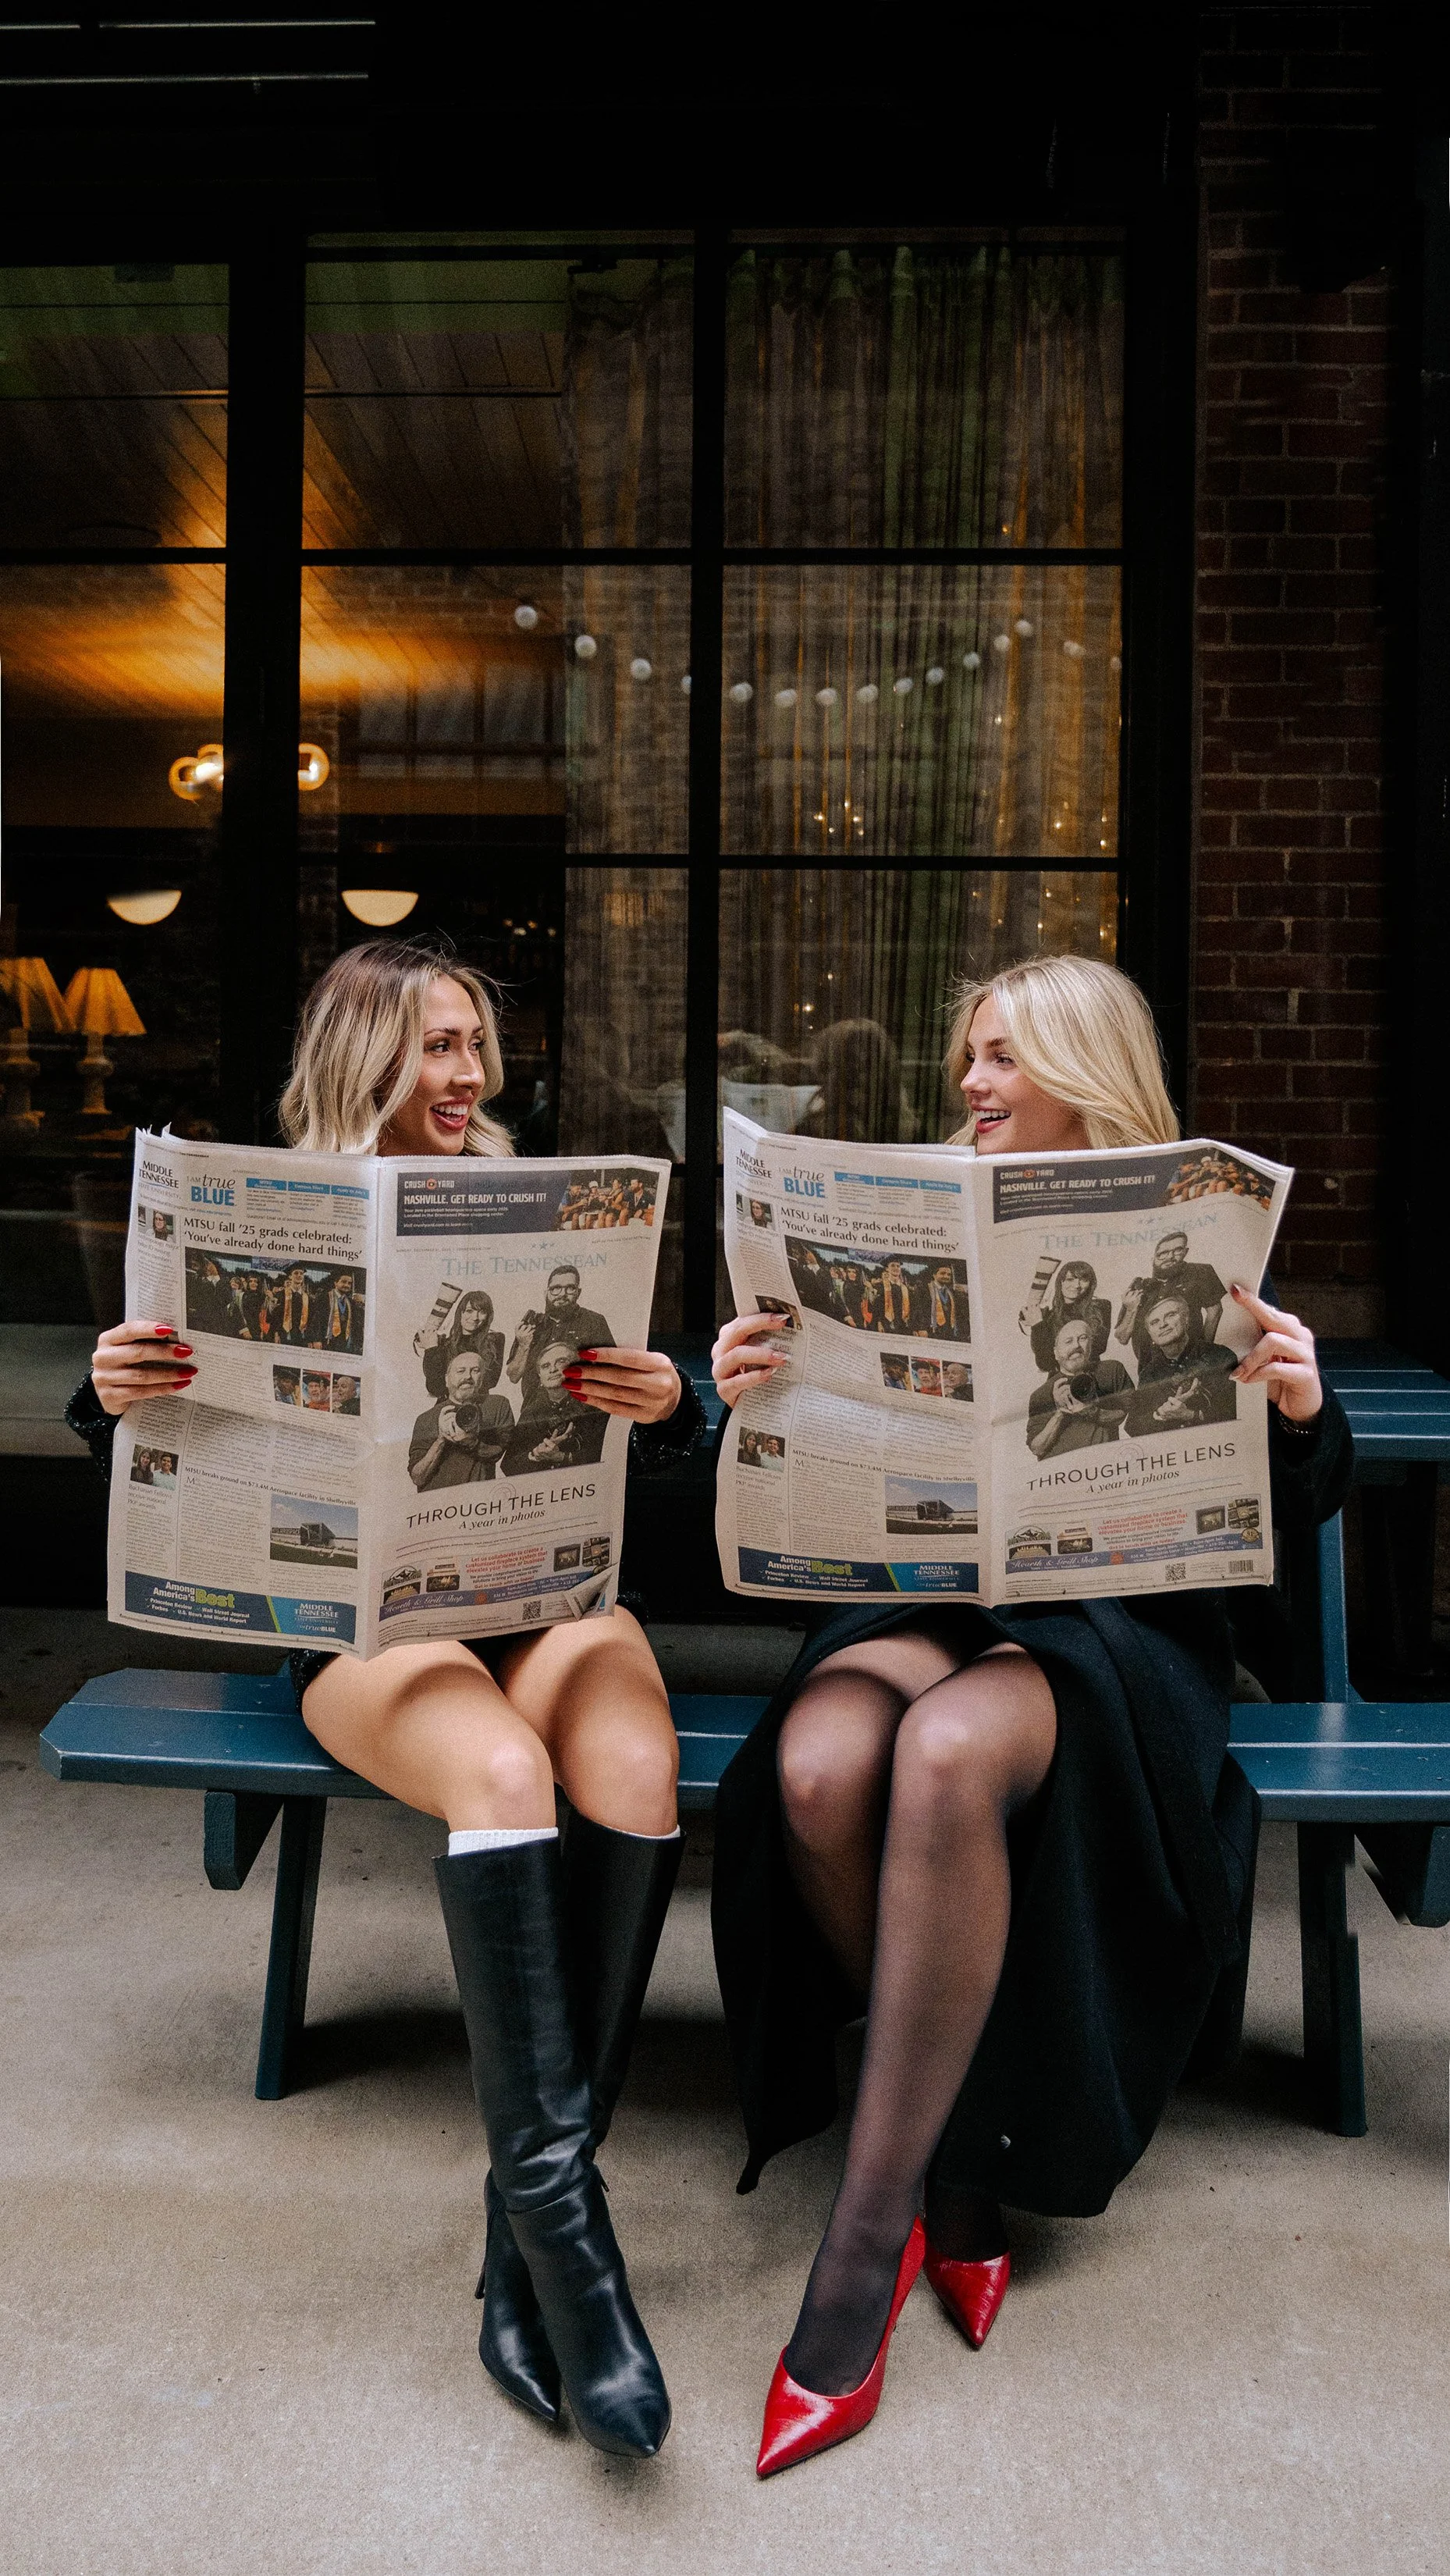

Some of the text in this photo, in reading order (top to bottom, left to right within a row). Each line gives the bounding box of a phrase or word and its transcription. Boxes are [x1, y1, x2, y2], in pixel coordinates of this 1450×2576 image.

[736, 1156, 773, 1179] TENNESSEE
[740, 1148, 766, 1169] MIDDLE
[143, 1160, 173, 1177] MIDDLE
[794, 1166, 825, 1183] true
[1000, 1171, 1023, 1180] CRUSH
[139, 1169, 179, 1188] TENNESSEE
[202, 1173, 236, 1189] true
[404, 1179, 455, 1189] CRUSH YARD
[784, 1176, 826, 1198] BLUE
[1050, 1180, 1065, 1190] GET
[1068, 1179, 1096, 1188] READY
[1100, 1178, 1111, 1187] TO
[1113, 1176, 1142, 1186] CRUSH
[1144, 1175, 1155, 1184] IT!
[191, 1186, 235, 1206] BLUE
[403, 1193, 547, 1205] NASHVILLE. GET READY TO CRUSH IT!
[184, 1218, 215, 1230] MTSU
[219, 1222, 235, 1233] fall
[259, 1227, 289, 1239] grads
[293, 1229, 352, 1244] celebrated:
[780, 1207, 810, 1220] MTSU
[813, 1212, 829, 1225] fall
[852, 1221, 881, 1232] grads
[885, 1223, 947, 1236] celebrated:
[224, 1236, 264, 1252] already
[268, 1240, 295, 1253] done
[298, 1244, 323, 1255] hard
[820, 1228, 858, 1244] already
[862, 1233, 889, 1245] done
[892, 1236, 918, 1248] hard
[442, 1252, 608, 1276] THE TENNESSEAN
[810, 1453, 829, 1462] breaks
[883, 1468, 913, 1477] Aerospace
[1026, 1443, 1235, 1490] THROUGH THE LENS
[202, 1470, 219, 1479] breaks
[220, 1475, 239, 1484] ground
[270, 1486, 297, 1496] Aerospace
[299, 1492, 318, 1500] facility
[1086, 1470, 1180, 1494] A year in photos
[406, 1483, 596, 1528] THROUGH THE LENS
[469, 1518, 495, 1531] year
[498, 1515, 508, 1525] in
[510, 1510, 546, 1525] photos
[768, 1560, 812, 1572] America's
[780, 1555, 811, 1565] Among
[812, 1560, 853, 1576] Best
[153, 1587, 195, 1602] America's
[165, 1582, 195, 1595] Among
[195, 1588, 235, 1608] Best
[150, 1598, 173, 1607] Princeton
[300, 1603, 333, 1611] MIDDLE
[294, 1609, 339, 1617] TENNESSEE
